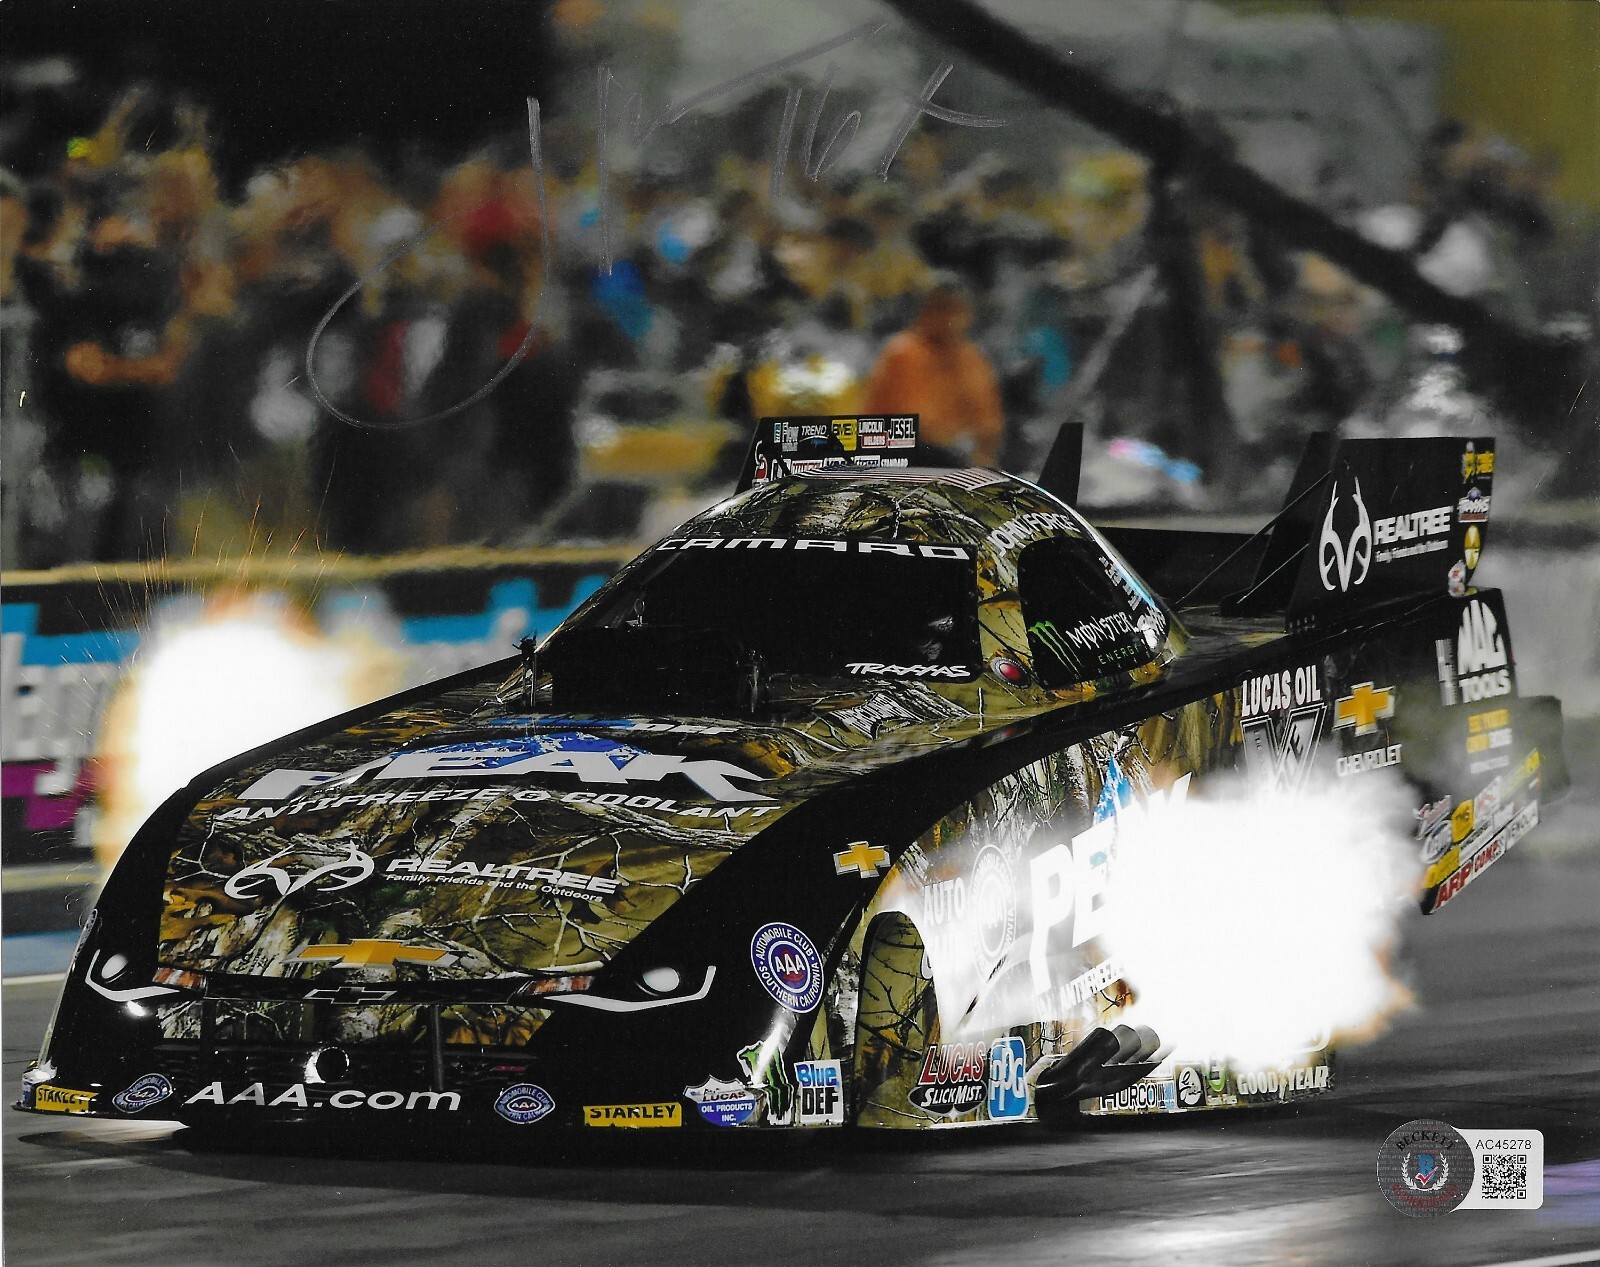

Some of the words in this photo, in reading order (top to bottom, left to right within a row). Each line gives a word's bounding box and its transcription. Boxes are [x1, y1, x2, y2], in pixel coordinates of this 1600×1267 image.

[801, 425, 827, 436] TREND
[859, 421, 883, 433] LINCOLN
[888, 419, 915, 440] JESEL
[985, 518, 1035, 558] JOHN
[1022, 512, 1081, 534] FORCE
[1373, 506, 1453, 546] REALTREE
[655, 538, 970, 560] CAMARO
[845, 663, 970, 678] TRAXXAS
[1242, 670, 1291, 717] LUCAS
[1295, 664, 1321, 706] OIL
[1459, 669, 1511, 704] TOOLS
[234, 750, 778, 801] PEAK
[1336, 744, 1403, 778] CHEVROLET
[217, 788, 507, 821] ANTIFREEZE
[561, 791, 782, 818] COOLANT
[385, 873, 430, 885] Family,
[435, 875, 484, 887] Friends
[487, 879, 512, 889] and
[516, 881, 537, 892] the
[541, 885, 604, 903] Outdoors
[386, 859, 623, 894] REALTREE
[1435, 862, 1472, 909] ARP
[924, 877, 966, 928] AUTO
[754, 926, 794, 961] AUTOMOBILE
[793, 932, 815, 956] CLUB
[774, 953, 806, 976] AAA
[758, 965, 800, 1008] SOUTHERN
[799, 961, 820, 1008] CALIFORNIA
[796, 1063, 838, 1087] Blue
[918, 1041, 987, 1085] LUCAS
[38, 1088, 84, 1104] STANLEY
[184, 1081, 462, 1111] AAA.com
[702, 1090, 746, 1102] LUCAS
[1236, 1066, 1331, 1096] GOODYEAR
[590, 1105, 676, 1119] STANLEY
[701, 1105, 714, 1113] OIL
[715, 1103, 753, 1112] PRODUCTS
[801, 1089, 839, 1116] DEF
[721, 1114, 737, 1122] INC.
[1395, 1130, 1456, 1152] BECKETT
[1475, 1139, 1532, 1150] AC45278
